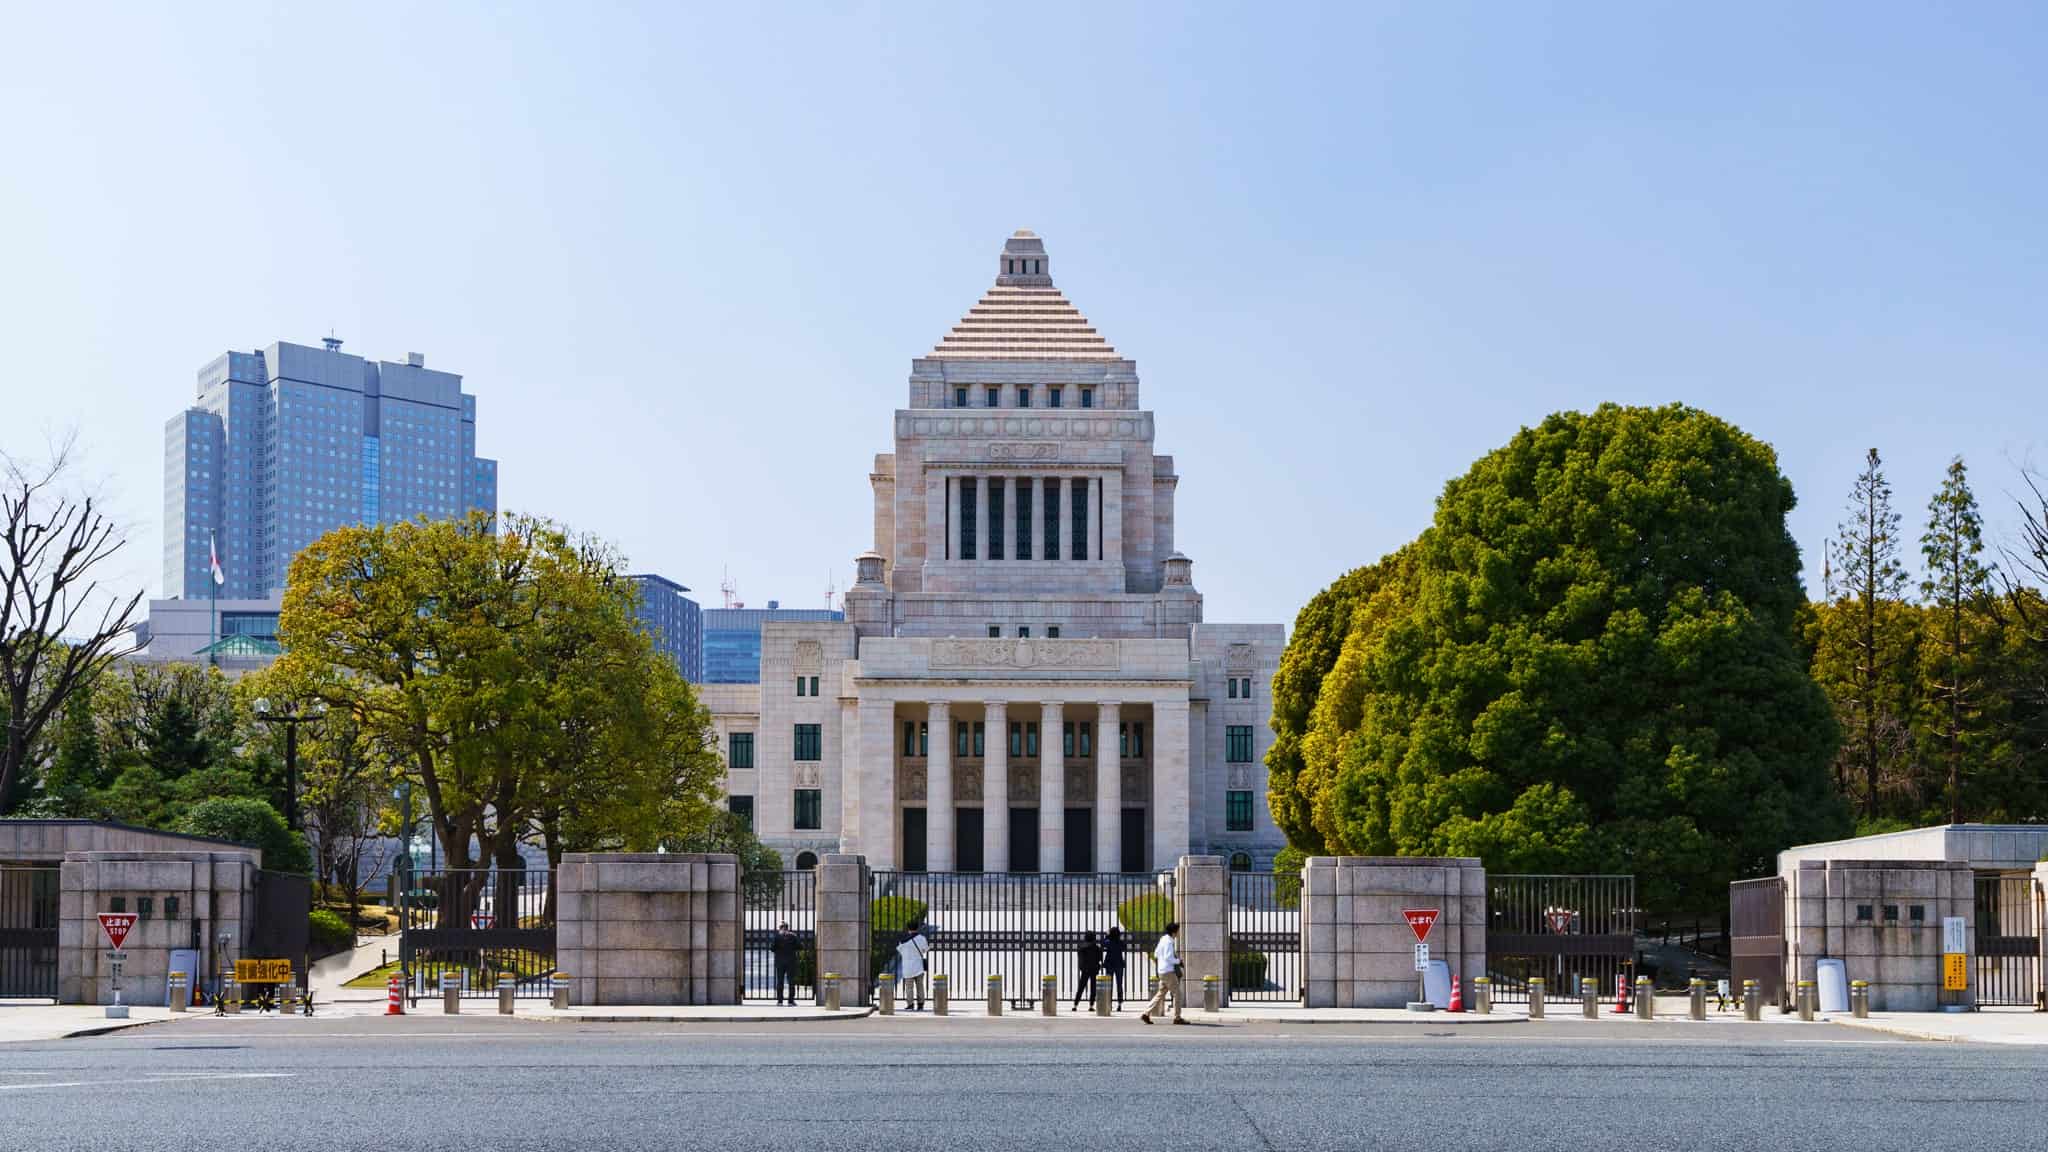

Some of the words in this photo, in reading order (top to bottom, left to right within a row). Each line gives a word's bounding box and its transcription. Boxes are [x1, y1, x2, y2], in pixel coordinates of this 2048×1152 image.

[1410, 916, 1433, 925] 止まれ
[110, 927, 127, 936] STOP
